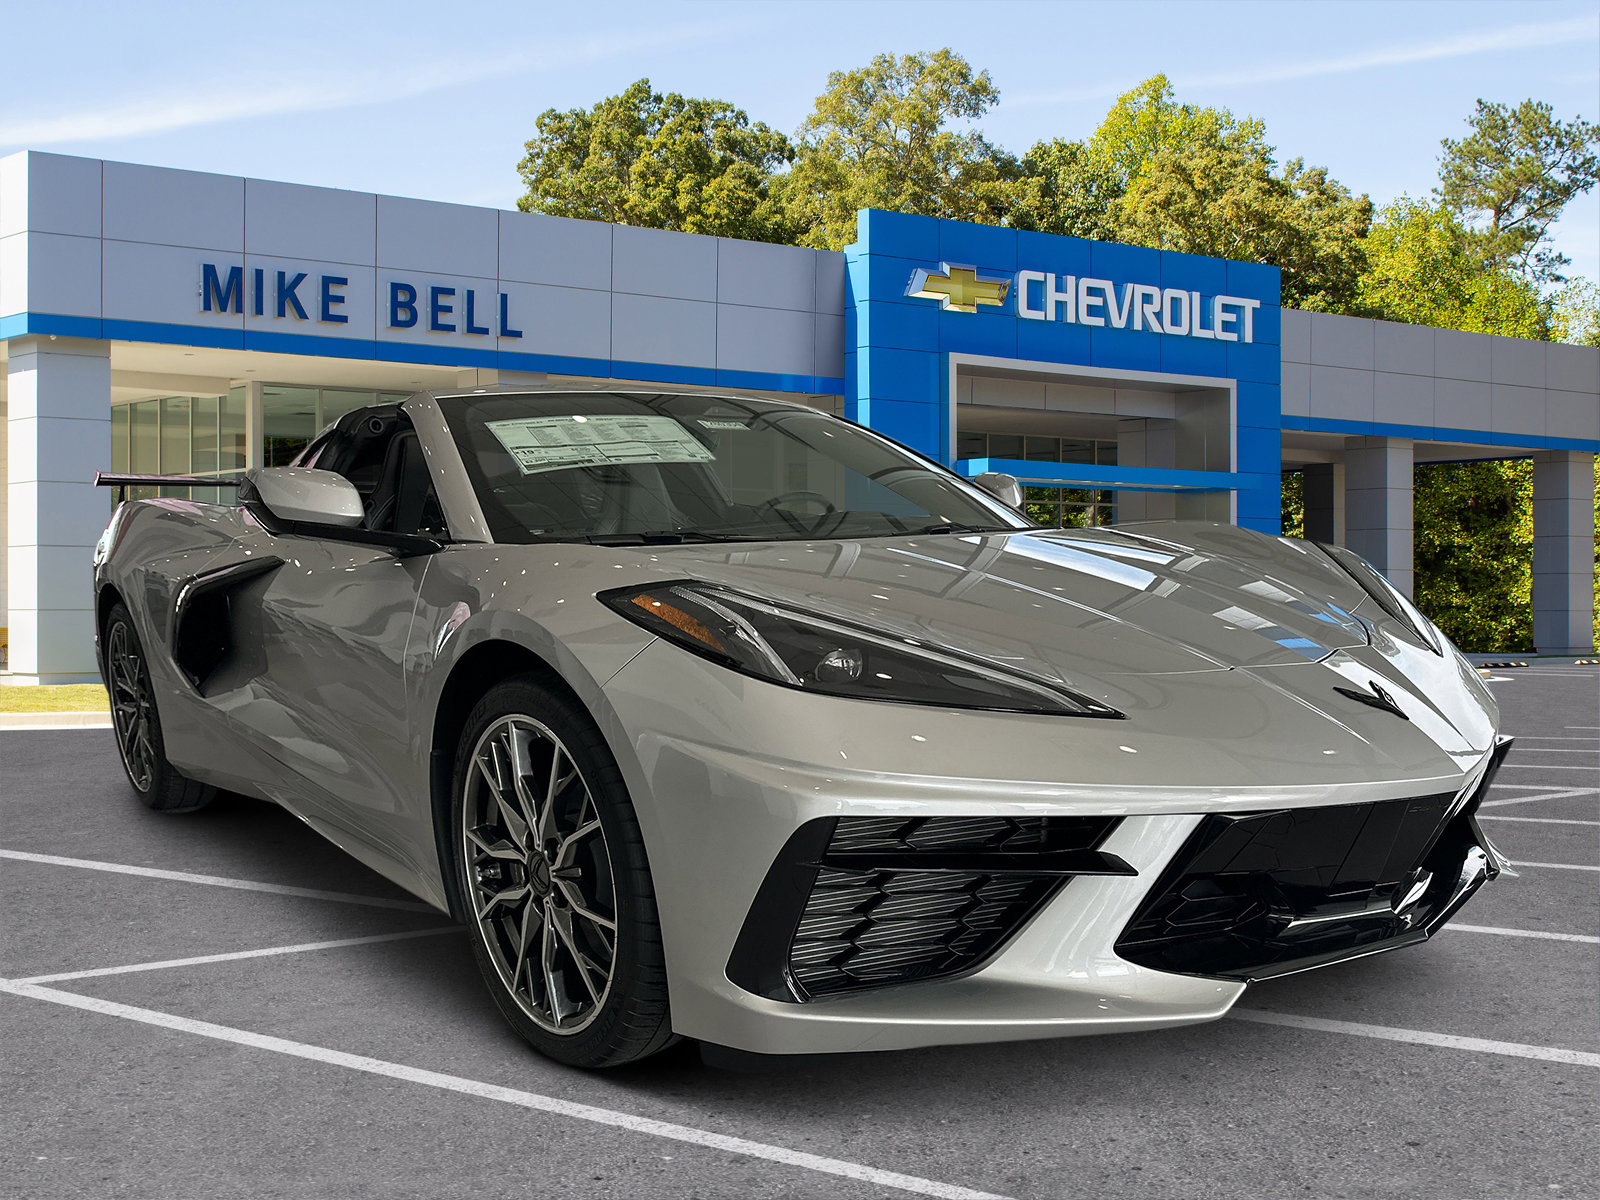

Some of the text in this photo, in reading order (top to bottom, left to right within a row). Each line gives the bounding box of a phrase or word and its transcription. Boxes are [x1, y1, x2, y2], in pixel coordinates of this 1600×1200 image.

[202, 263, 523, 339] MIKE BELL
[1016, 269, 1261, 343] CHEVROLET
